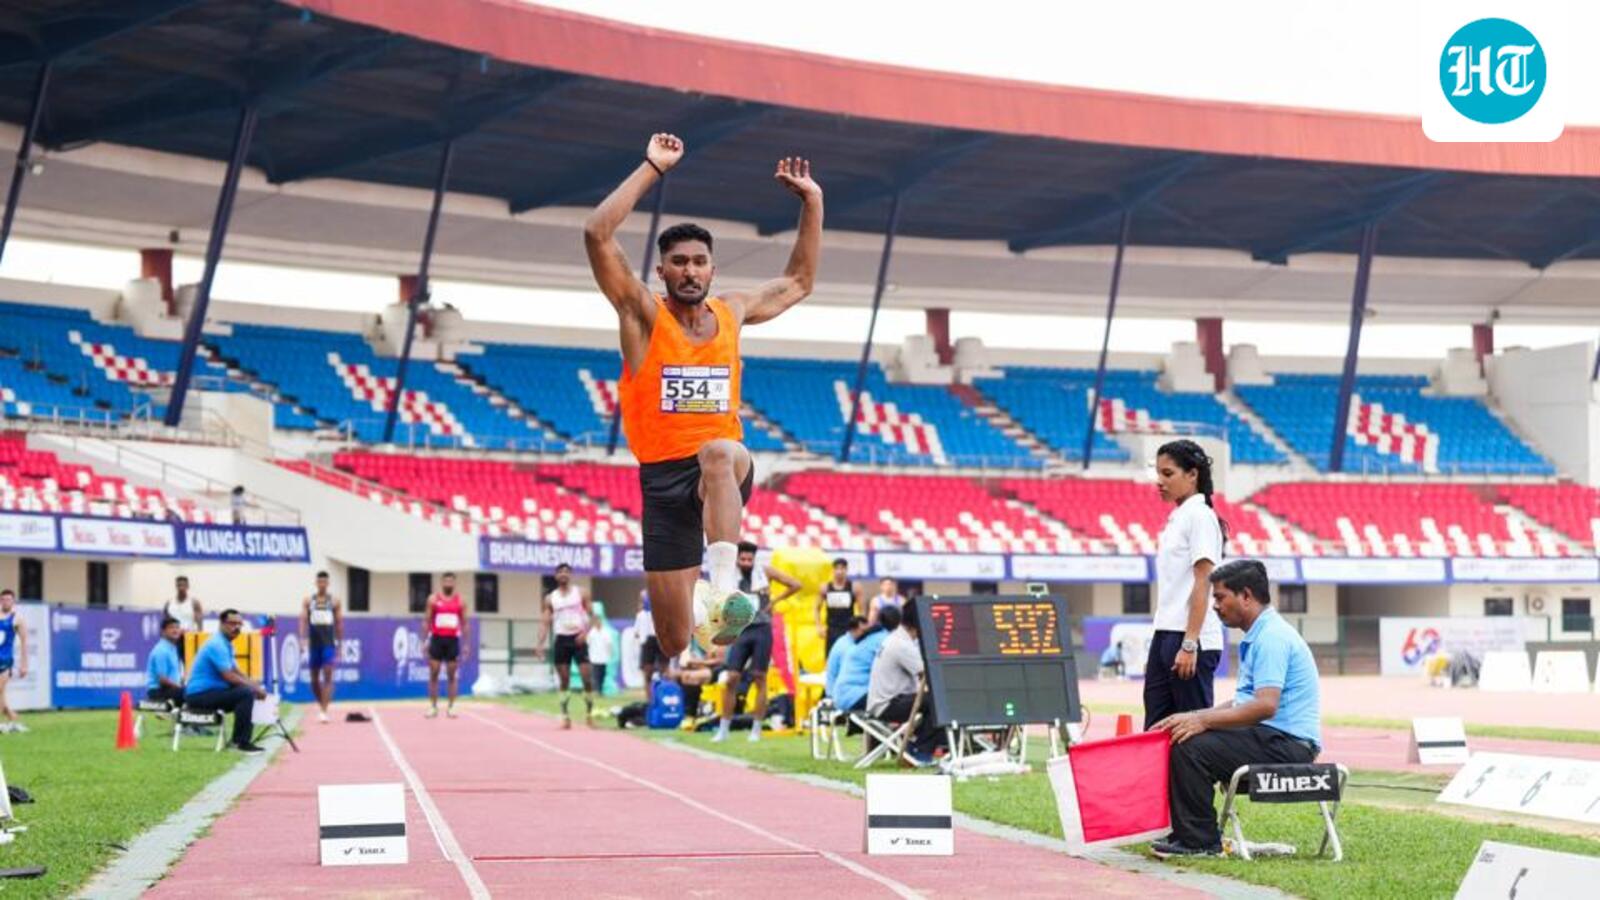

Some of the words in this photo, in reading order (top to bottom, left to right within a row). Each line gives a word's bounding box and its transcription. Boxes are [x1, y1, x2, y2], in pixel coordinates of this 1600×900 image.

[666, 380, 710, 398] 554
[185, 528, 245, 555] KALINGA
[245, 531, 306, 557] STADIUM
[490, 541, 593, 569] BHUBANESWAR
[931, 604, 960, 654] 2
[1256, 772, 1331, 793] Vinex
[1520, 770, 1552, 806] 6
